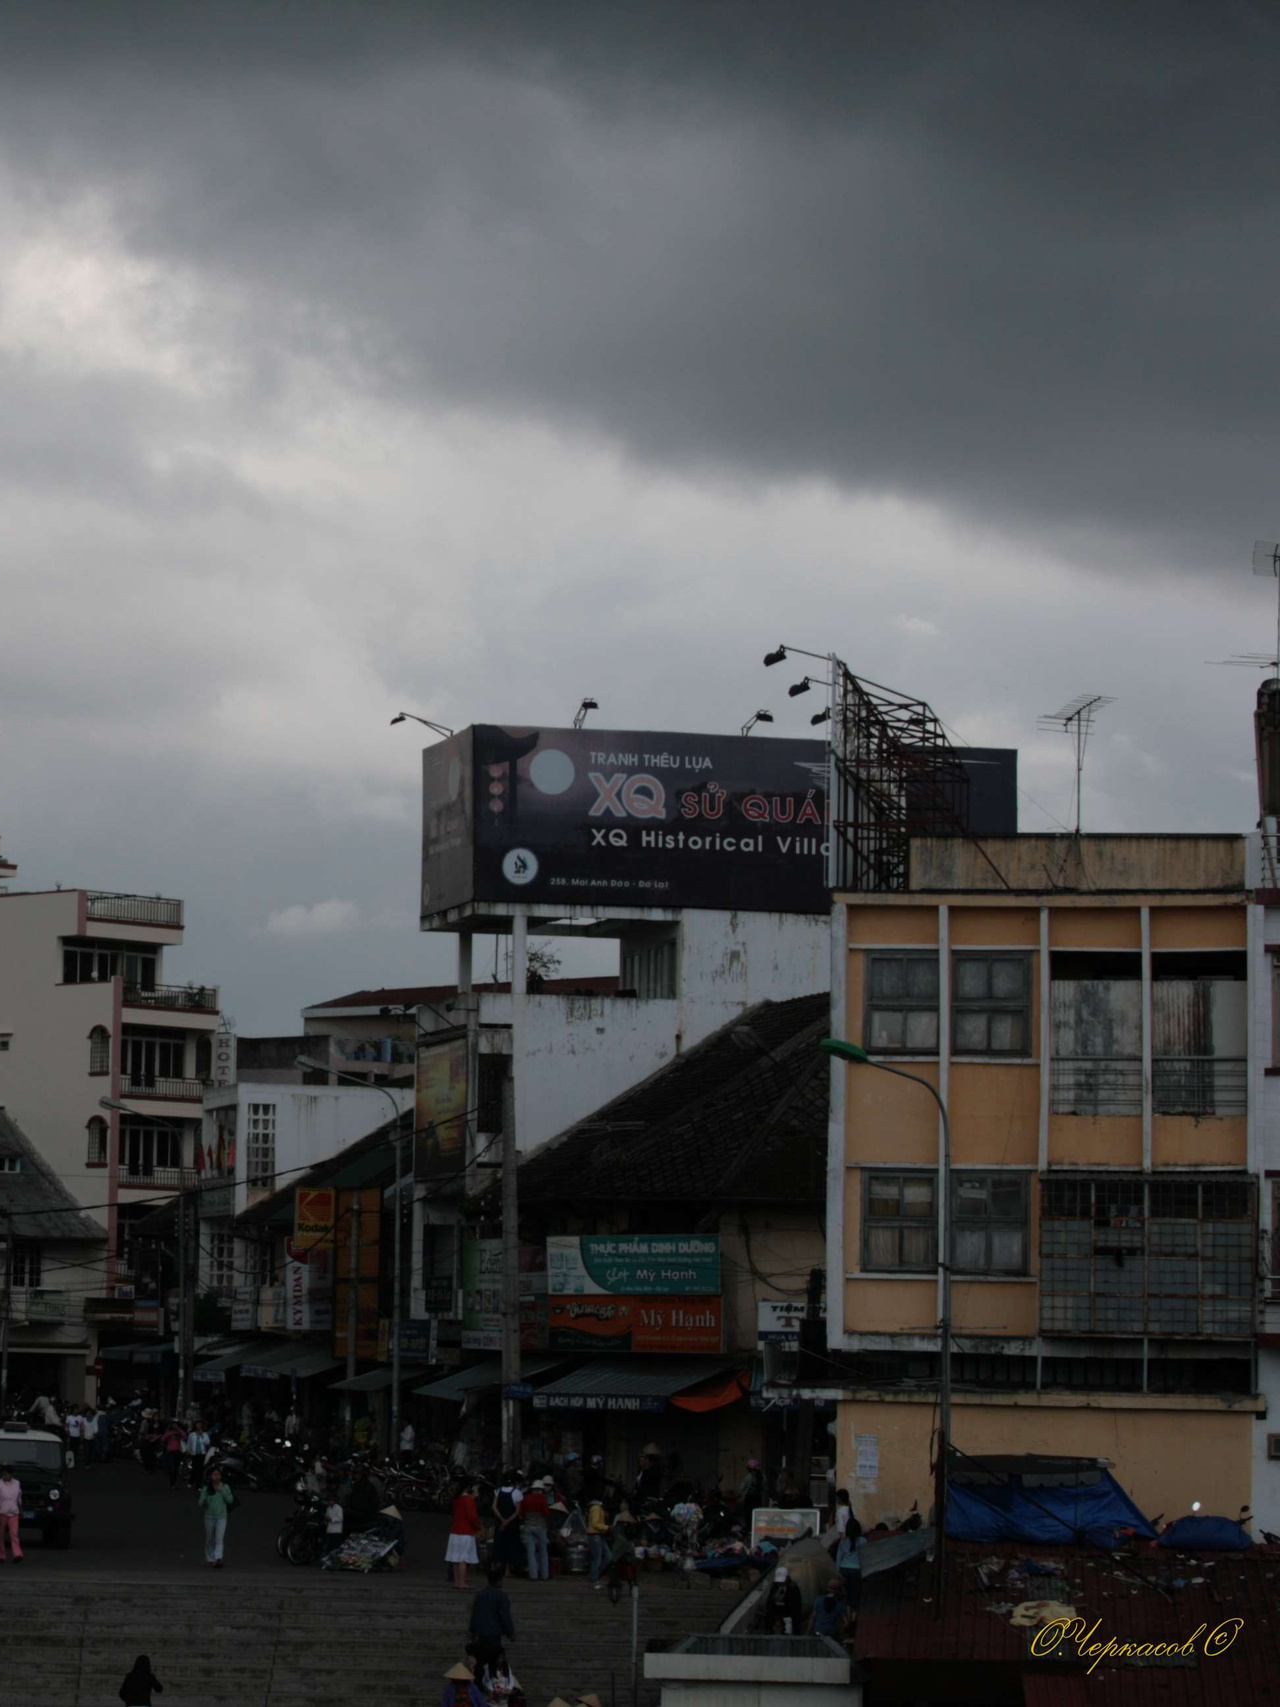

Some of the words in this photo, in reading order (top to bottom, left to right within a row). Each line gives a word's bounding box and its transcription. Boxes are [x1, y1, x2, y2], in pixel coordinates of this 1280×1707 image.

[589, 751, 638, 767] TRANH
[643, 752, 679, 769] THÊU
[685, 755, 713, 773] LỤA
[588, 773, 666, 819] XQ
[681, 781, 726, 819] SỬ
[742, 789, 831, 826] QUÁ
[590, 828, 628, 847] XQ
[641, 830, 763, 853] Historical
[298, 1222, 331, 1233] Kodak
[636, 1269, 656, 1282] Mỹ
[661, 1269, 697, 1281] Hạnh
[293, 1266, 303, 1326] KYMDAN
[640, 1309, 665, 1331] Mỹ
[671, 1309, 716, 1331] Hạnh
